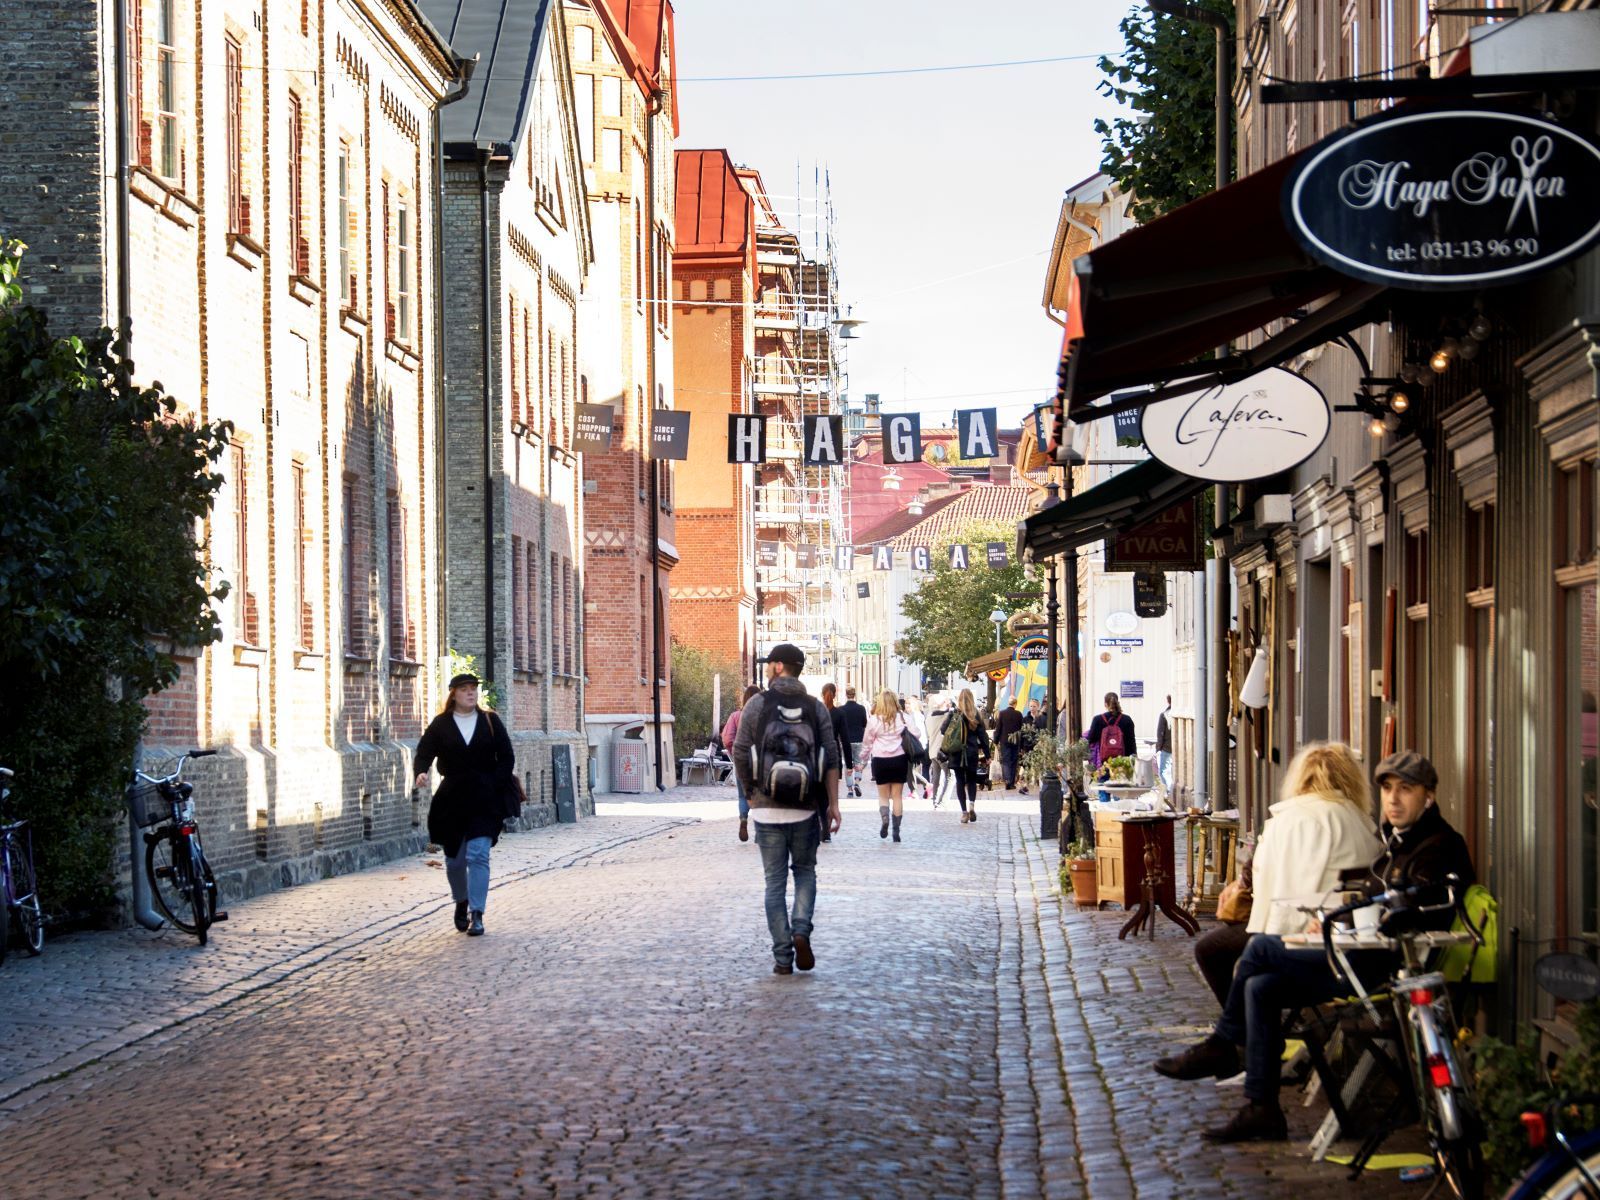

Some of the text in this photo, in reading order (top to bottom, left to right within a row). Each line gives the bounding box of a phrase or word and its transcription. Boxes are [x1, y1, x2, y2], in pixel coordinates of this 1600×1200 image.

[1338, 159, 1450, 218] Haga
[1387, 237, 1539, 261] tel: 031-13 96 90
[578, 415, 596, 424] COSY
[577, 423, 611, 433] SHOPPING
[654, 425, 676, 434] SINCE
[584, 432, 601, 441] FIKA
